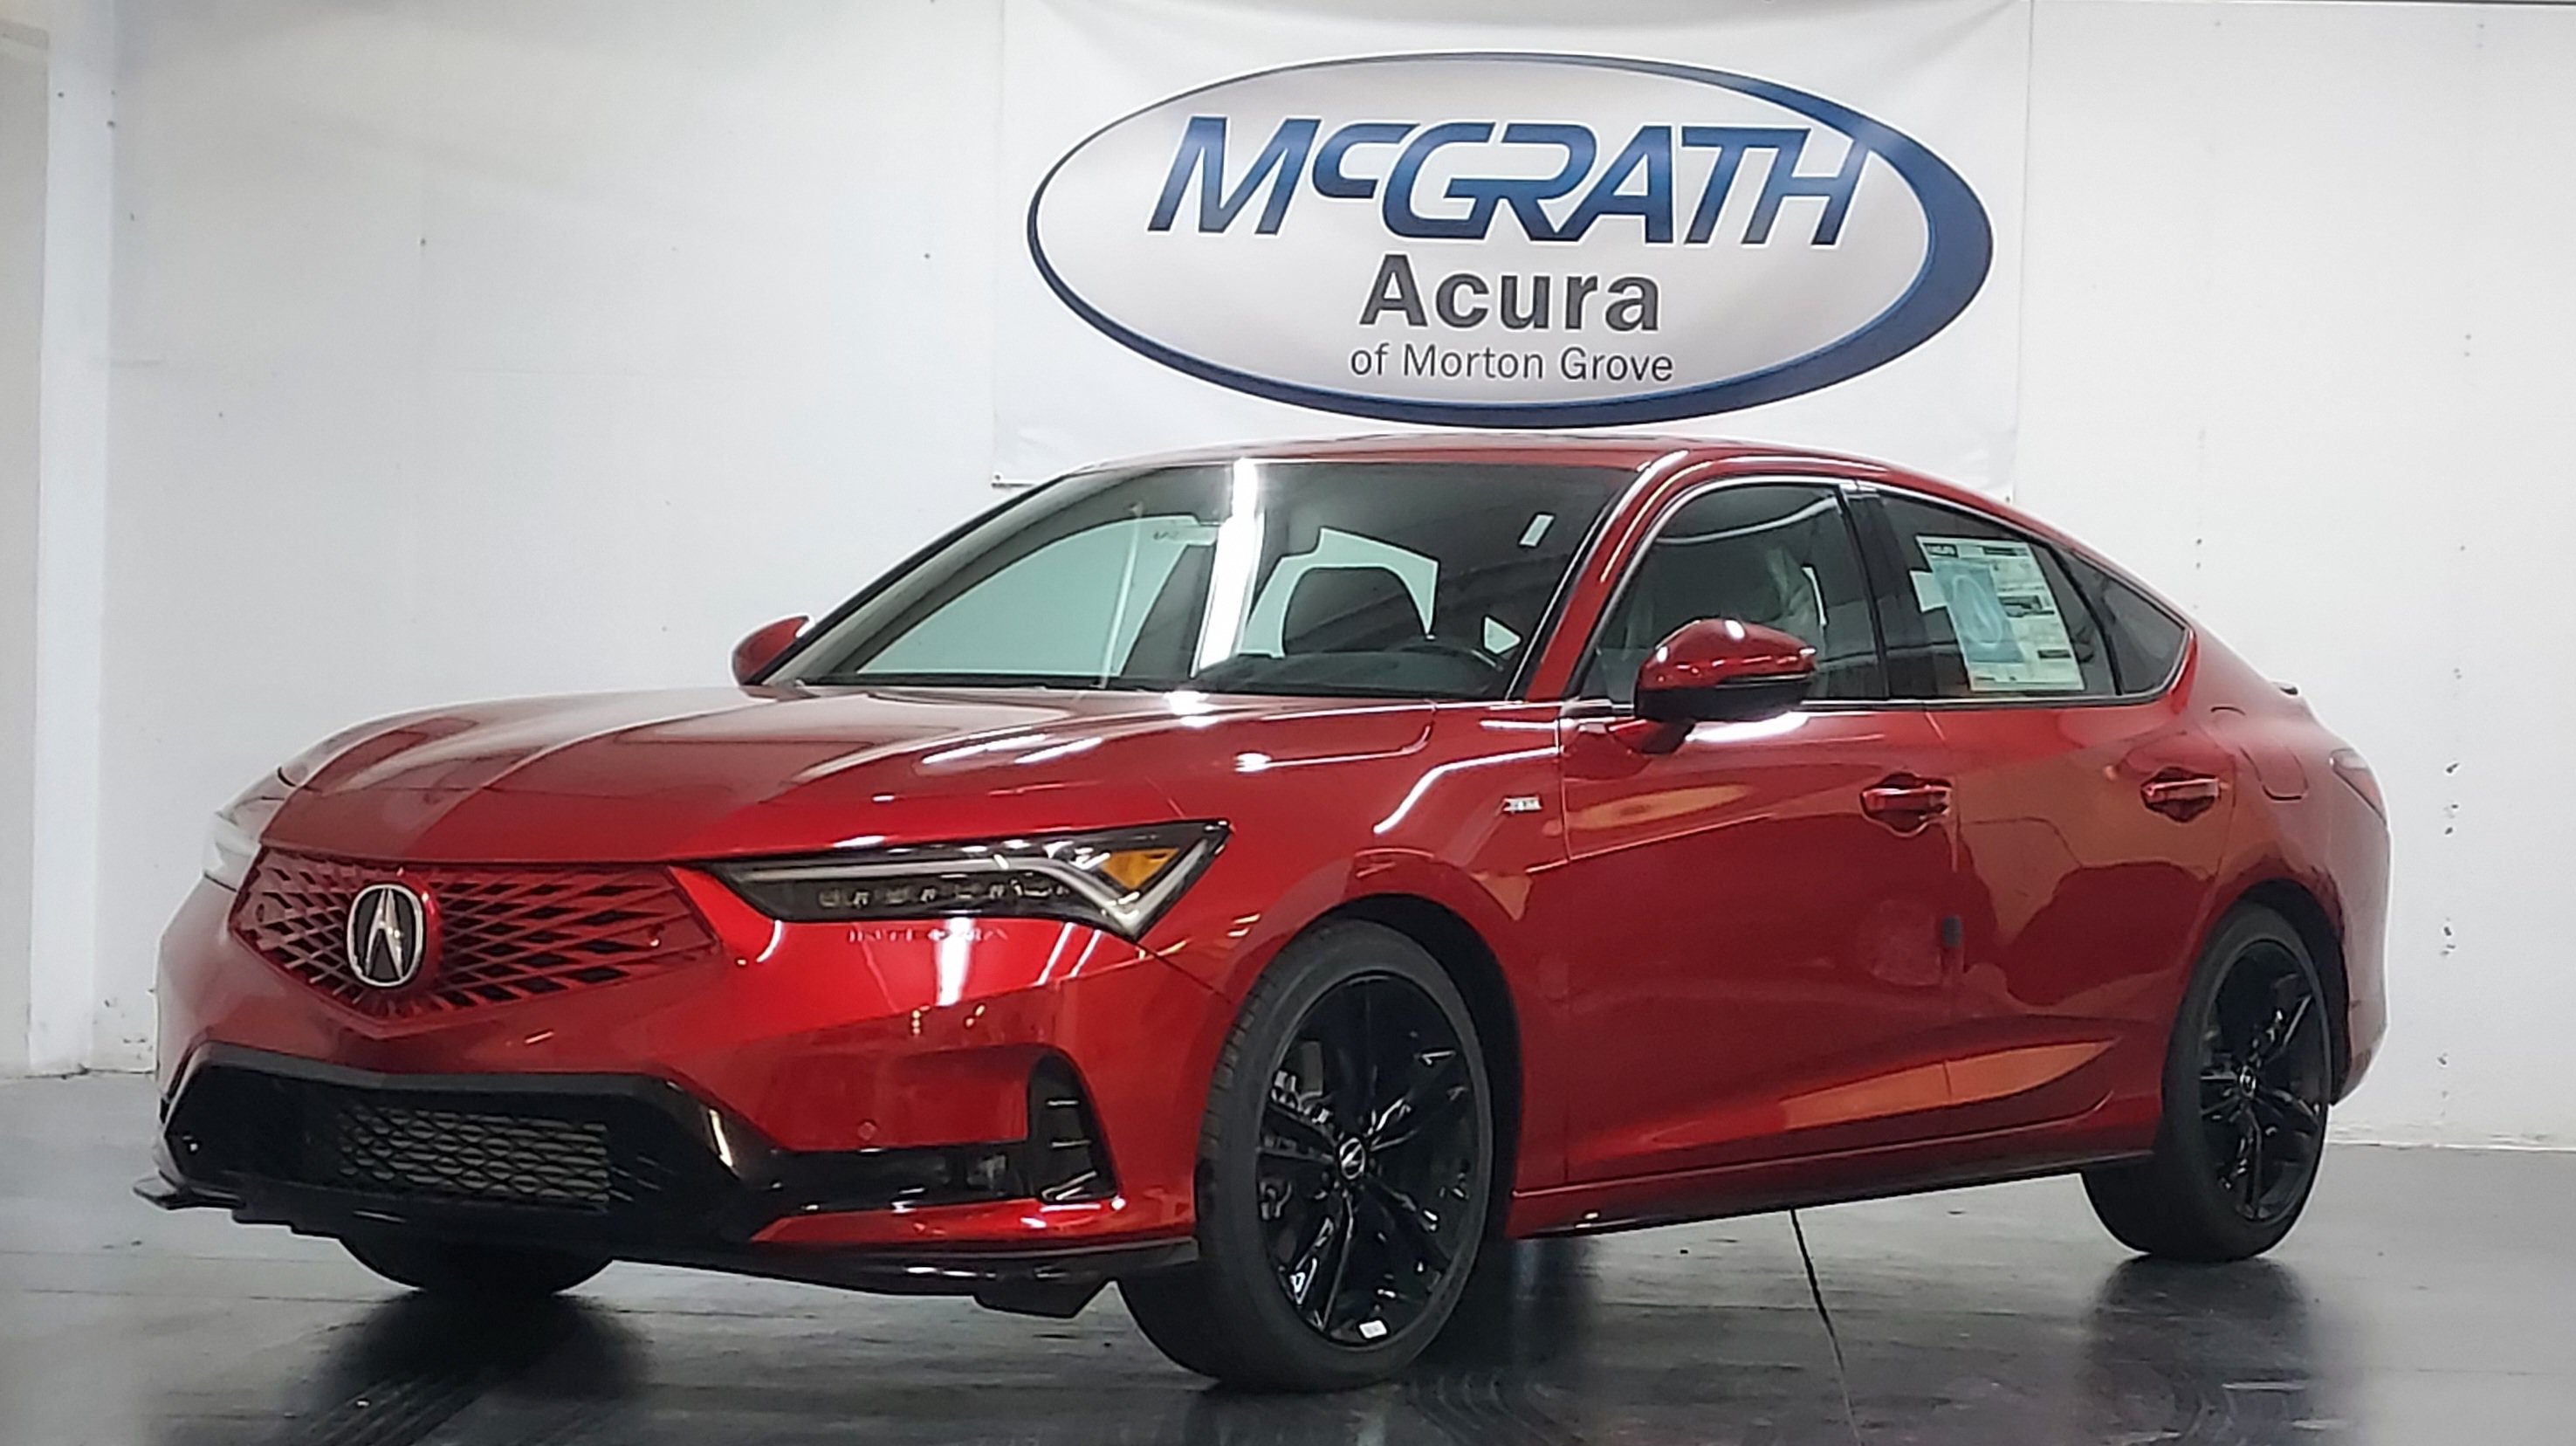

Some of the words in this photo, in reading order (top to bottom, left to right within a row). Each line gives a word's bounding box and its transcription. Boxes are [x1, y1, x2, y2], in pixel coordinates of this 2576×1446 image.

[1359, 254, 1659, 331] Acura
[1350, 343, 1390, 375] of
[1404, 344, 1544, 379] Morton
[1561, 348, 1673, 381] Grove
